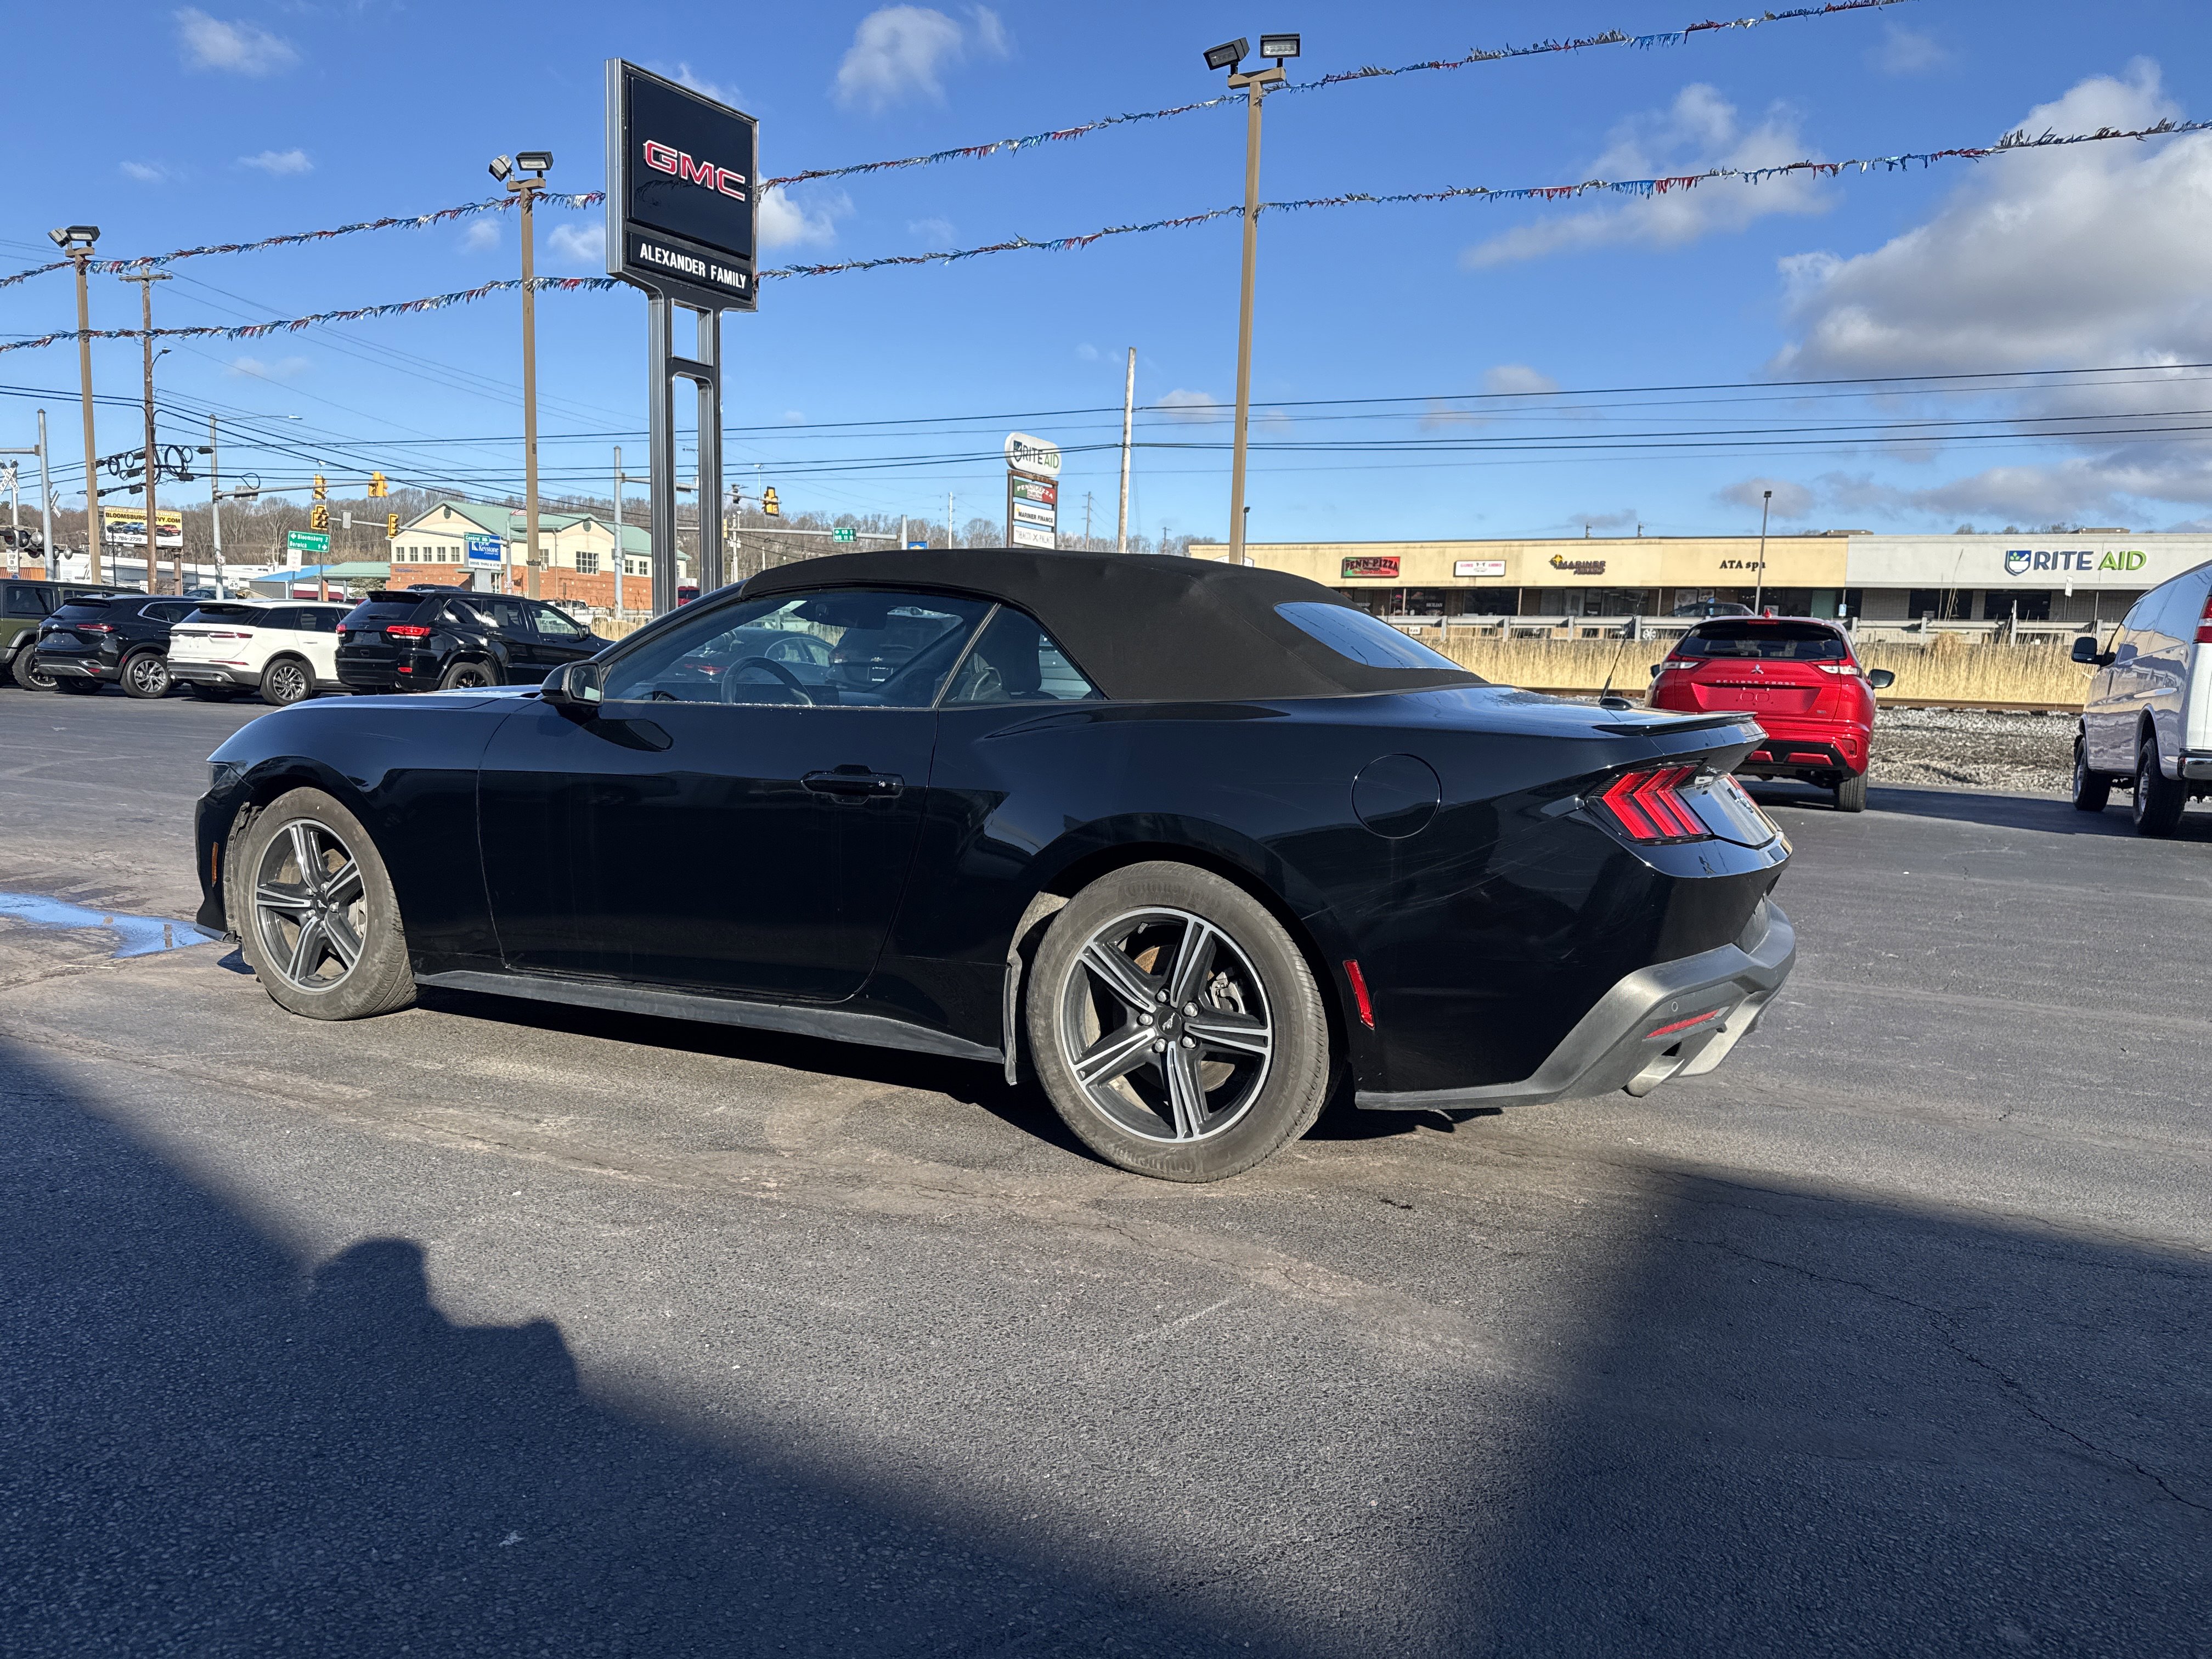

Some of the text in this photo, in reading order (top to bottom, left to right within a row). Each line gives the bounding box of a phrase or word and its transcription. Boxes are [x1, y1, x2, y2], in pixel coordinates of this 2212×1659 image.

[643, 139, 746, 202] GMC
[640, 242, 746, 289] ALEXANDER FAMILY
[1023, 444, 1059, 469] RITE AID
[1035, 486, 1053, 499] PIZZA
[105, 512, 181, 524] BLOOMSBURGEVY.COM
[1018, 511, 1053, 523] MARINER FINANCE
[297, 533, 323, 543] Bloomsburg
[479, 545, 499, 553] Keystone
[1345, 558, 1398, 572] PENN PIZZA
[1558, 560, 1606, 569] MARINER
[1719, 560, 1743, 569] ATA
[2033, 550, 2147, 571] RITE AID
